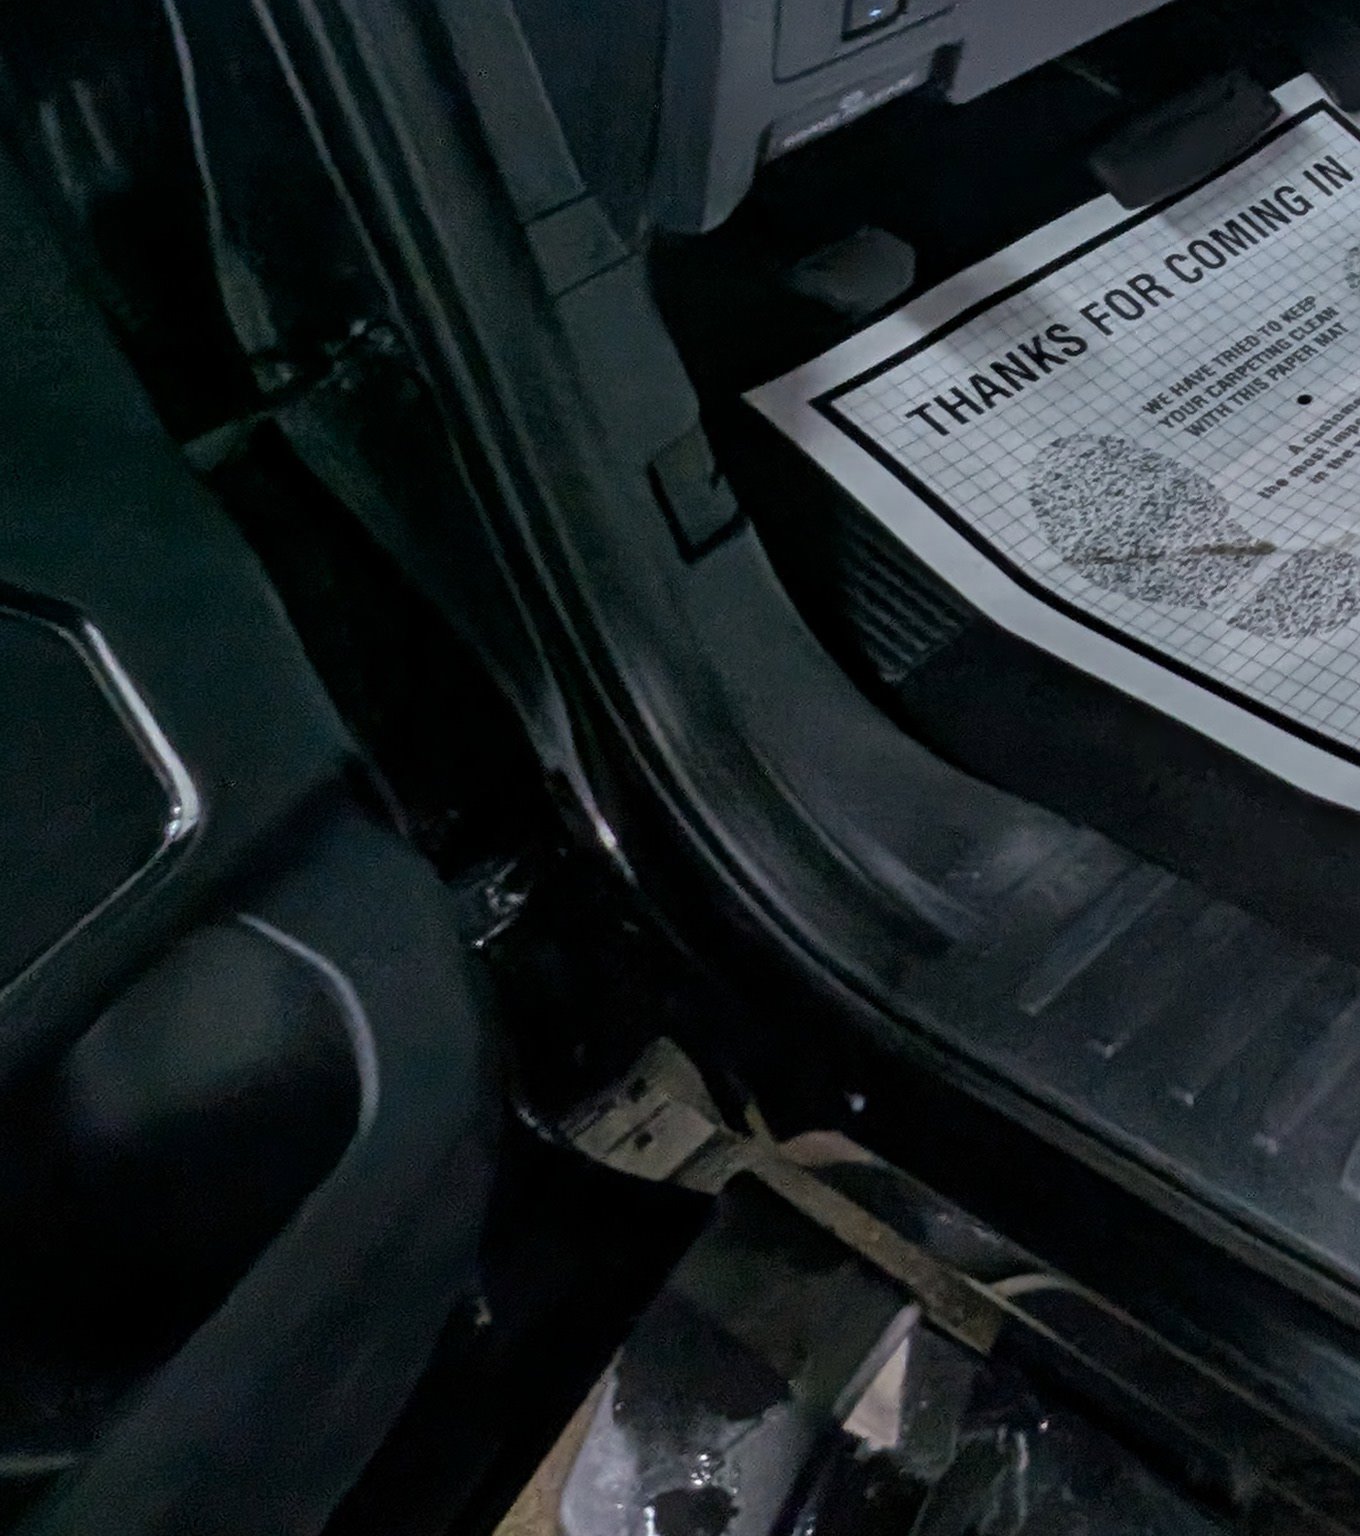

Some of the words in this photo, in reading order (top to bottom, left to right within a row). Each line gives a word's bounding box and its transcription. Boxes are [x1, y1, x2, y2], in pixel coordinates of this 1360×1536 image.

[905, 322, 1088, 437] THANKS
[1080, 273, 1175, 337] FOR
[1164, 185, 1314, 284] COMING
[1303, 155, 1355, 197] IN
[1142, 392, 1171, 415] WE
[1169, 364, 1216, 397] HAVE
[1212, 334, 1261, 368] TRIED
[1257, 320, 1283, 338] TO
[1279, 295, 1316, 323] KEEP
[1158, 395, 1209, 429] YOUR
[1205, 338, 1293, 399] CARPETING
[1288, 306, 1340, 342] CLEAN
[1184, 402, 1233, 437] WITH
[1227, 377, 1270, 407] THIS
[1266, 344, 1318, 381] PAPER
[1314, 321, 1349, 347] MAT
[1258, 477, 1289, 500] the
[1289, 446, 1330, 477] most
[1288, 445, 1305, 456] A
[1326, 449, 1355, 470] the
